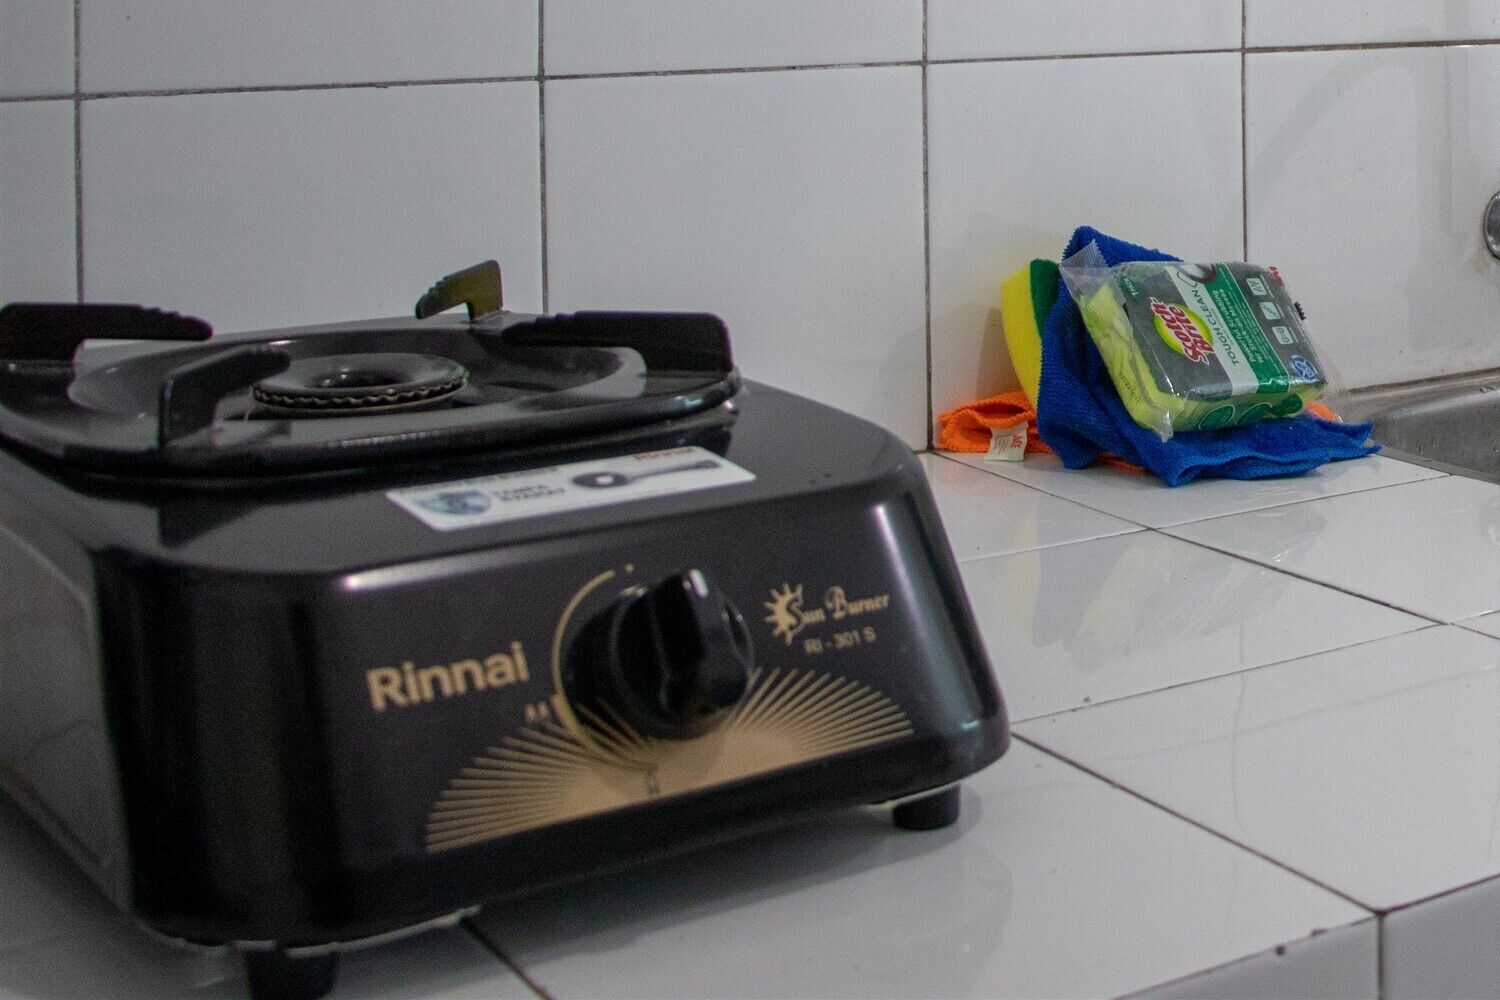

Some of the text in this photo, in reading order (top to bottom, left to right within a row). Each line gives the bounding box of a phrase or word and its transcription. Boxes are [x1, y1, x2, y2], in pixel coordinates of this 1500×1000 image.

[1190, 288, 1217, 326] CLEAN
[1211, 289, 1236, 328] Scrubbing
[1217, 287, 1237, 317] Messes
[1168, 305, 1216, 353] Brite
[1211, 326, 1240, 366] TOUGH
[1232, 316, 1257, 352] Stuck-on
[1232, 328, 1257, 363] Powerful
[824, 585, 891, 620] Burner
[365, 640, 530, 713] Rinnai
